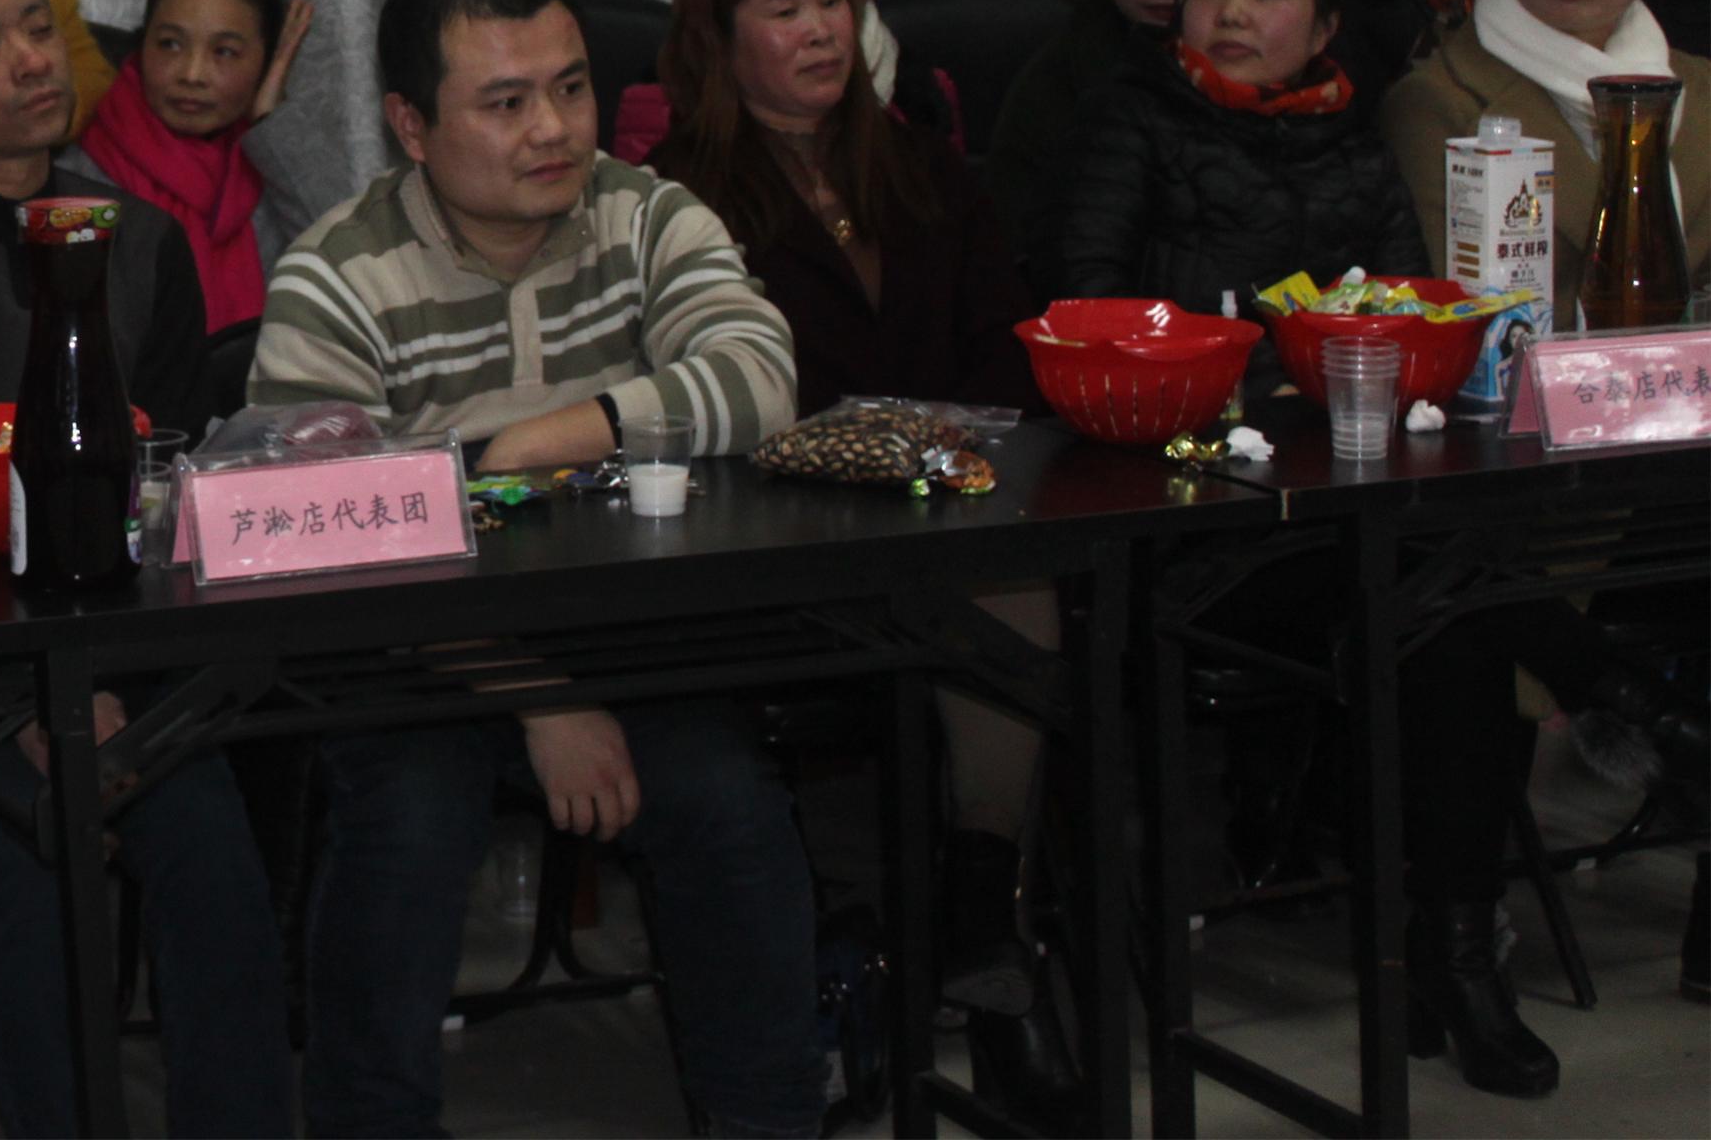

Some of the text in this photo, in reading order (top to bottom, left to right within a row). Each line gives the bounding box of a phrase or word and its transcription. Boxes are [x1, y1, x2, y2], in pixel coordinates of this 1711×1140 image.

[229, 491, 429, 546] 芦淞店代表团
